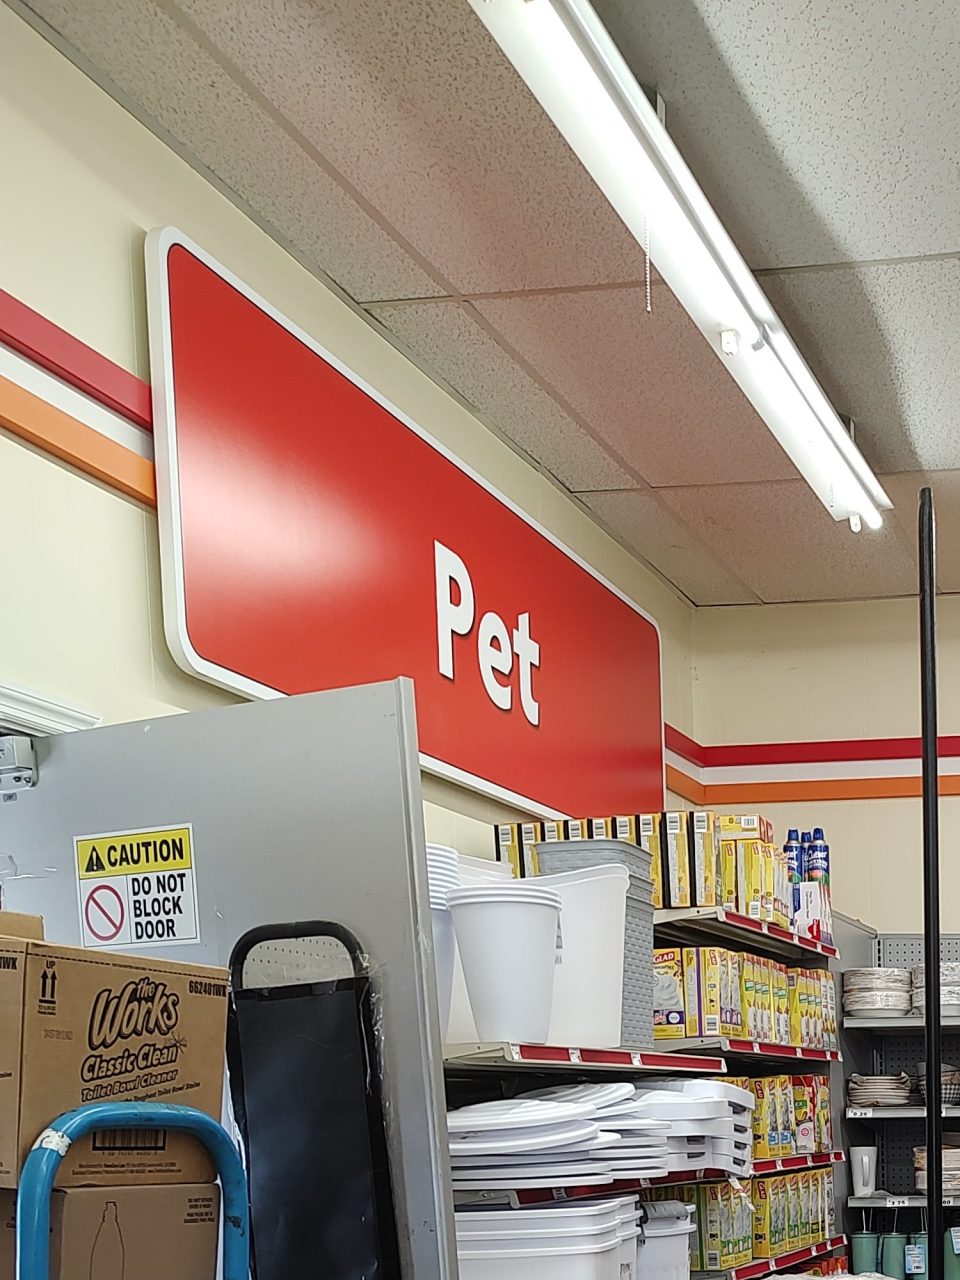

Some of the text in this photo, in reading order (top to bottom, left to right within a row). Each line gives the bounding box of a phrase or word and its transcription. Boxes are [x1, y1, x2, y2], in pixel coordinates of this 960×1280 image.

[433, 539, 540, 727] Pet
[107, 838, 184, 868] CAUTION
[131, 873, 186, 897] DO NOT
[133, 896, 183, 918] BLOCK
[135, 919, 176, 940] DOOR
[45, 960, 56, 969] UP
[653, 951, 675, 964] GLAD
[137, 979, 156, 998] the
[189, 980, 227, 998] 662401WK
[89, 976, 180, 1051] Works
[81, 1043, 179, 1082] Classic Clean
[81, 1069, 179, 1102] Toilet Bowl Cleaner
[157, 1088, 171, 1097] Toilet
